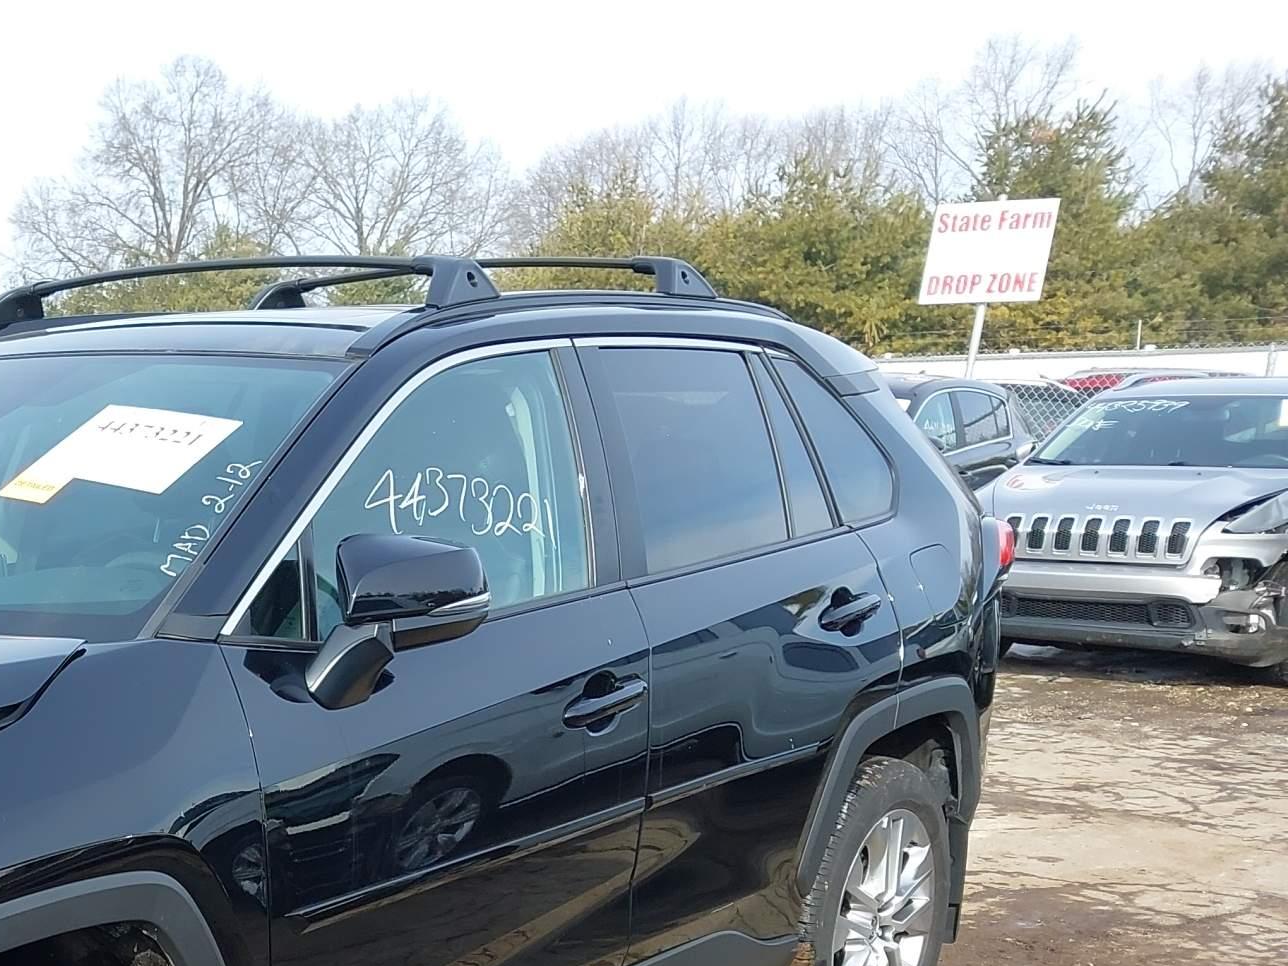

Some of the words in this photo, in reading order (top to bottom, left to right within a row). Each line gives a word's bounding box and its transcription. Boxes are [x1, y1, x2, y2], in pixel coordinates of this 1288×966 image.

[937, 213, 992, 233] State
[997, 210, 1052, 230] Farm
[926, 273, 982, 296] DROP
[986, 271, 1039, 294] ZONE
[364, 467, 558, 550] 44373221
